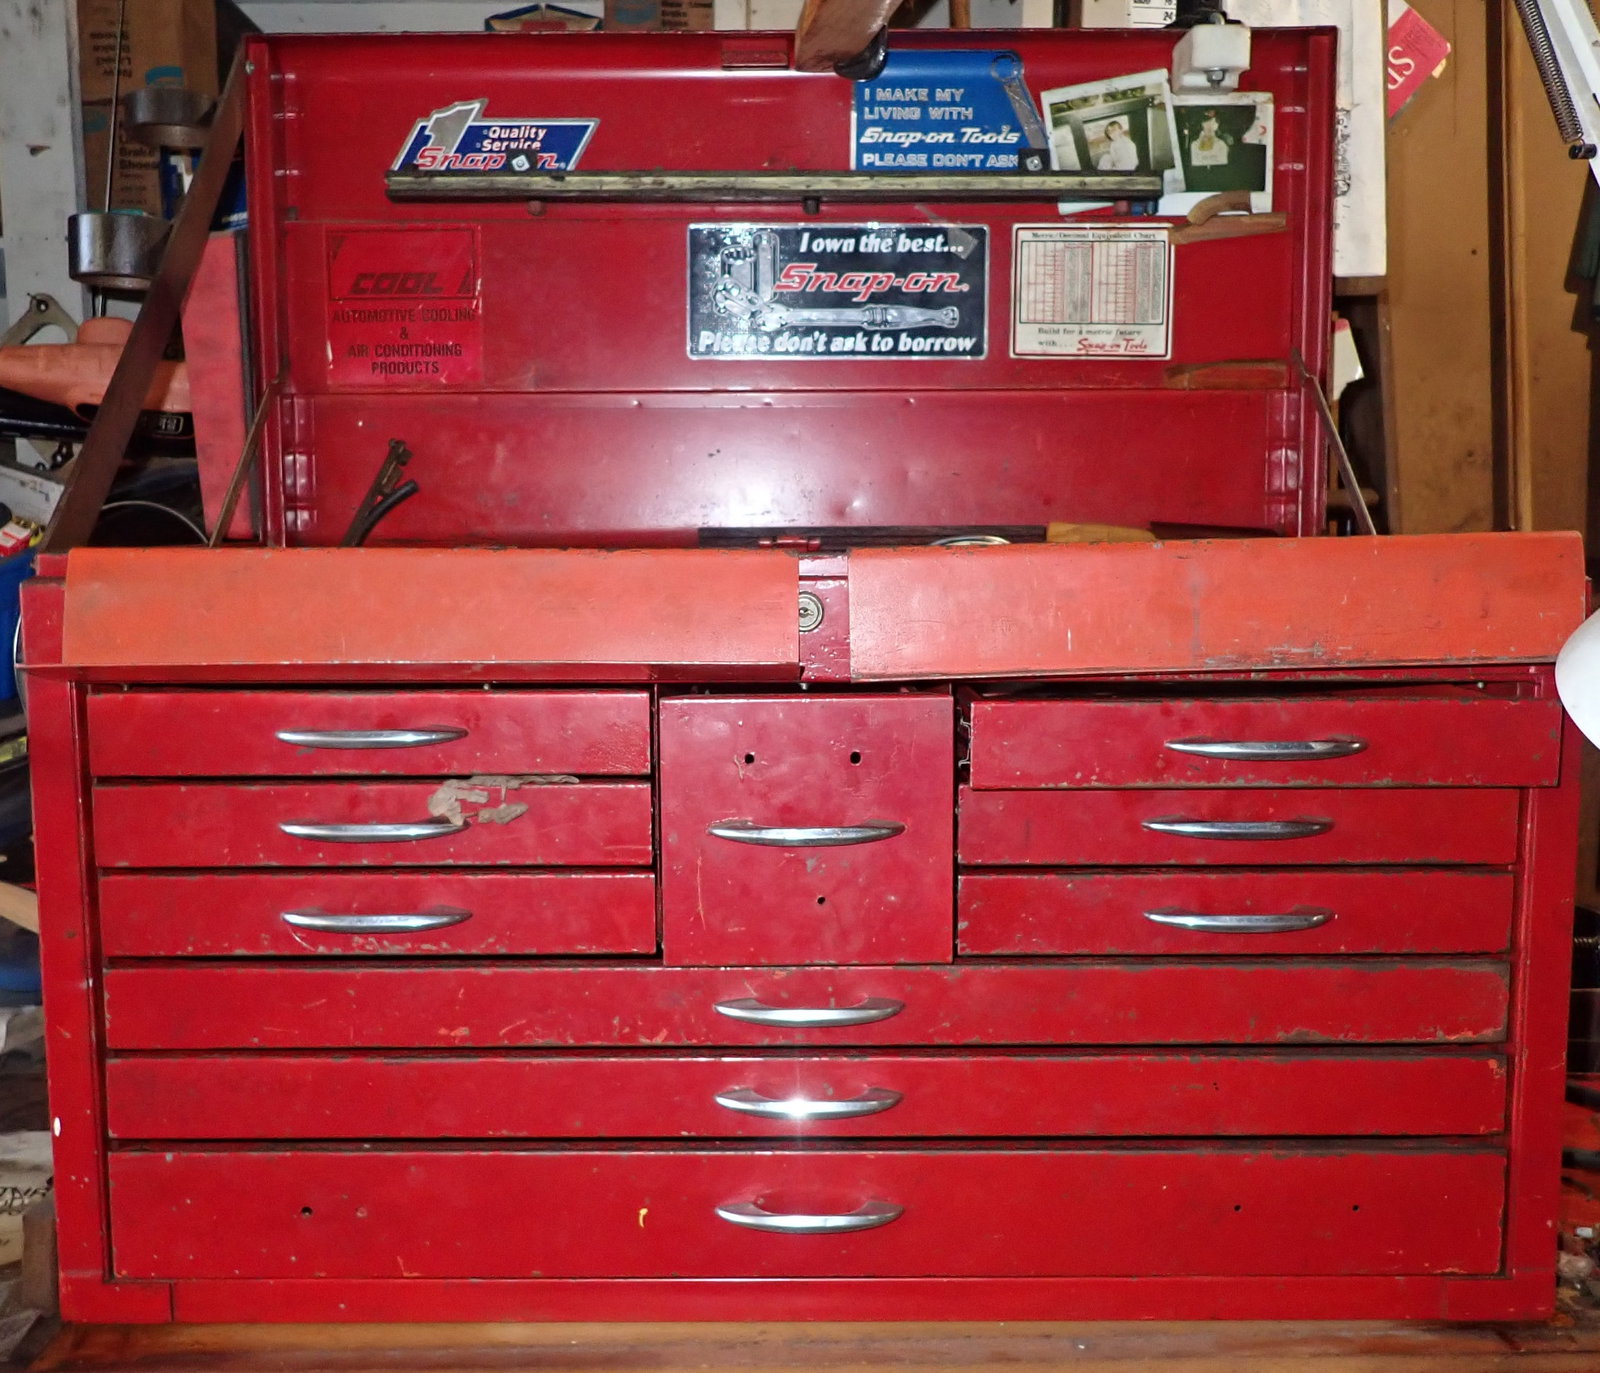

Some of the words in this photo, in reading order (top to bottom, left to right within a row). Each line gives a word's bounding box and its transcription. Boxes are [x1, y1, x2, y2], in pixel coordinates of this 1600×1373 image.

[864, 88, 869, 101] I
[876, 88, 929, 101] MAKE
[935, 88, 964, 101] MY
[864, 107, 921, 120] LIVING
[929, 107, 973, 120] WITH
[489, 126, 547, 140] Quality
[860, 126, 955, 147] Snap-on
[960, 125, 1021, 143] Tools
[482, 139, 541, 151] Service
[863, 154, 928, 167] PLEASE
[933, 154, 983, 167] DON'T
[986, 155, 1018, 168] ASK
[800, 232, 811, 253] I
[812, 236, 855, 253] own
[859, 234, 892, 252] the
[349, 272, 444, 295] COOL
[333, 309, 416, 323] AUTOMOTIVE
[421, 307, 476, 322] COOLING
[400, 327, 408, 340] &
[774, 331, 826, 352] don't
[830, 332, 867, 351] ask
[870, 333, 893, 352] to
[898, 332, 977, 352] borrow
[348, 345, 369, 357] AIR
[374, 344, 462, 357] CONDITIONING
[371, 361, 439, 375] PRODUCTS
